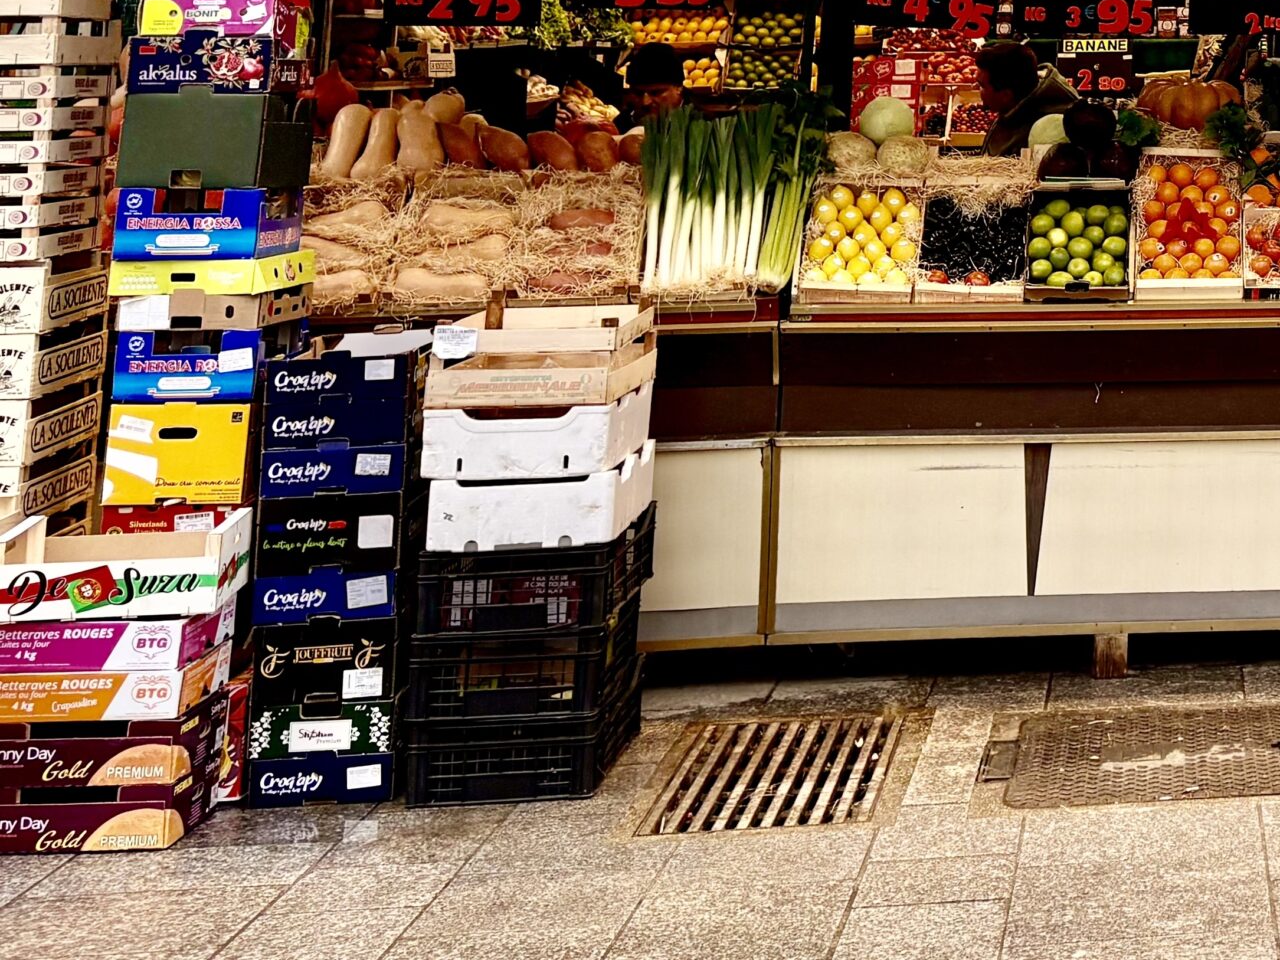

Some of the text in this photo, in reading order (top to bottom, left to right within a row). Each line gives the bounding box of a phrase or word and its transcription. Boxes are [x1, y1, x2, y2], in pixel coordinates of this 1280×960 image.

[1025, 7, 1046, 21] KG
[1065, 40, 1127, 51] BANANE
[127, 217, 190, 229] ENERGIA
[129, 360, 192, 373] ENERGIA
[34, 404, 96, 446] LA SOCULENTE
[26, 465, 91, 511] LA SOCULENTE
[8, 568, 202, 616] De Suza
[63, 628, 114, 639] ROUGES
[32, 641, 51, 650] four
[136, 638, 167, 649] BTG
[15, 651, 37, 661] 4 kg
[61, 679, 113, 690] ROUGES
[29, 691, 47, 700] four
[136, 688, 167, 699] BTG
[21, 701, 34, 712] kg
[27, 747, 56, 763] Day
[42, 760, 93, 781] Gold
[106, 766, 164, 778] PREMIUM
[20, 817, 49, 832] Day
[35, 830, 87, 851] Gold
[100, 835, 158, 847] PREMIUM
